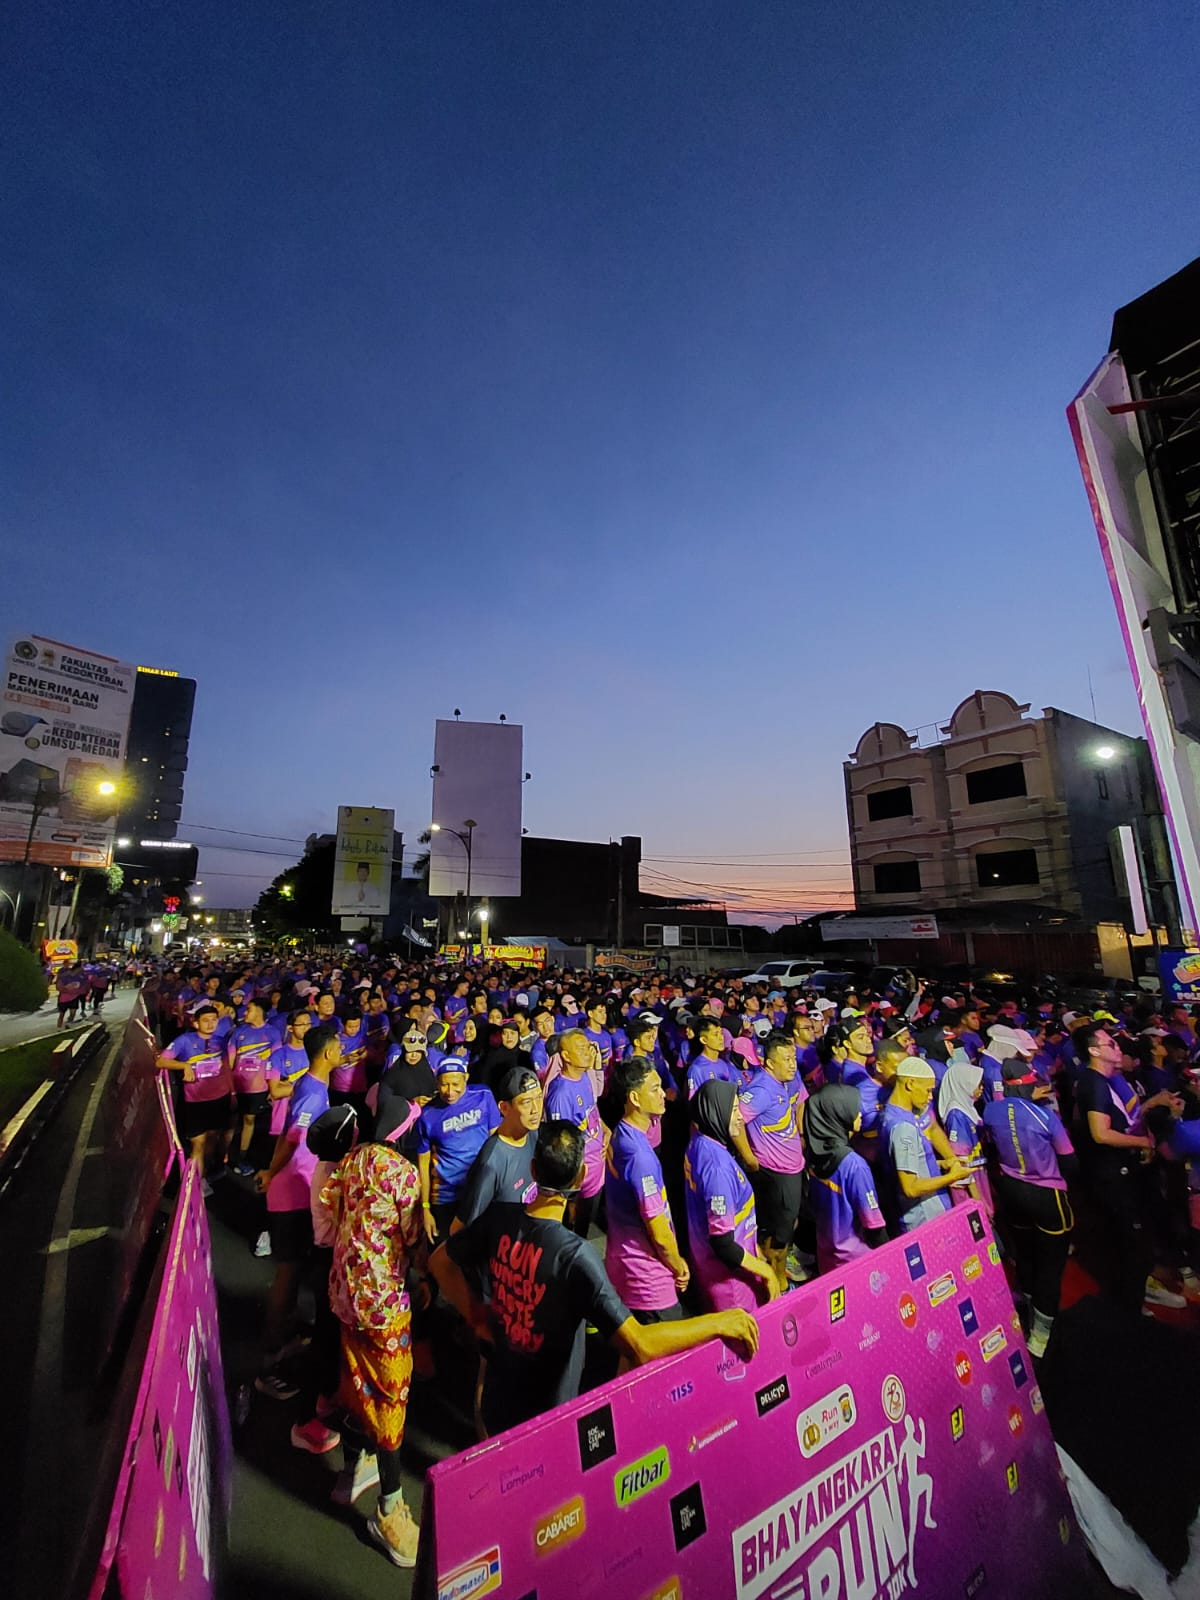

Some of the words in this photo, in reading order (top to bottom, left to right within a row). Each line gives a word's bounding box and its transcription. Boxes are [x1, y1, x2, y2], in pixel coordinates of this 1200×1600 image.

[60, 664, 123, 687] KEDOKTERAN
[61, 655, 108, 675] FAKULTAS
[160, 669, 179, 678] LAUT
[7, 683, 69, 703] MAHASISWA
[72, 698, 98, 710] BARU
[8, 672, 99, 703] PENERIMAAN
[42, 735, 119, 758] UMSU-MEDAN
[52, 727, 120, 749] KEDOKTERAN
[497, 1234, 543, 1283] RUN
[831, 1289, 844, 1315] EJ
[671, 1381, 693, 1402] TISS
[822, 1407, 838, 1422] Run
[500, 1464, 544, 1493] Lampung
[621, 1458, 666, 1501] Fitbar
[741, 1431, 894, 1588] BHAYANGKARA
[536, 1507, 581, 1546] CABARET
